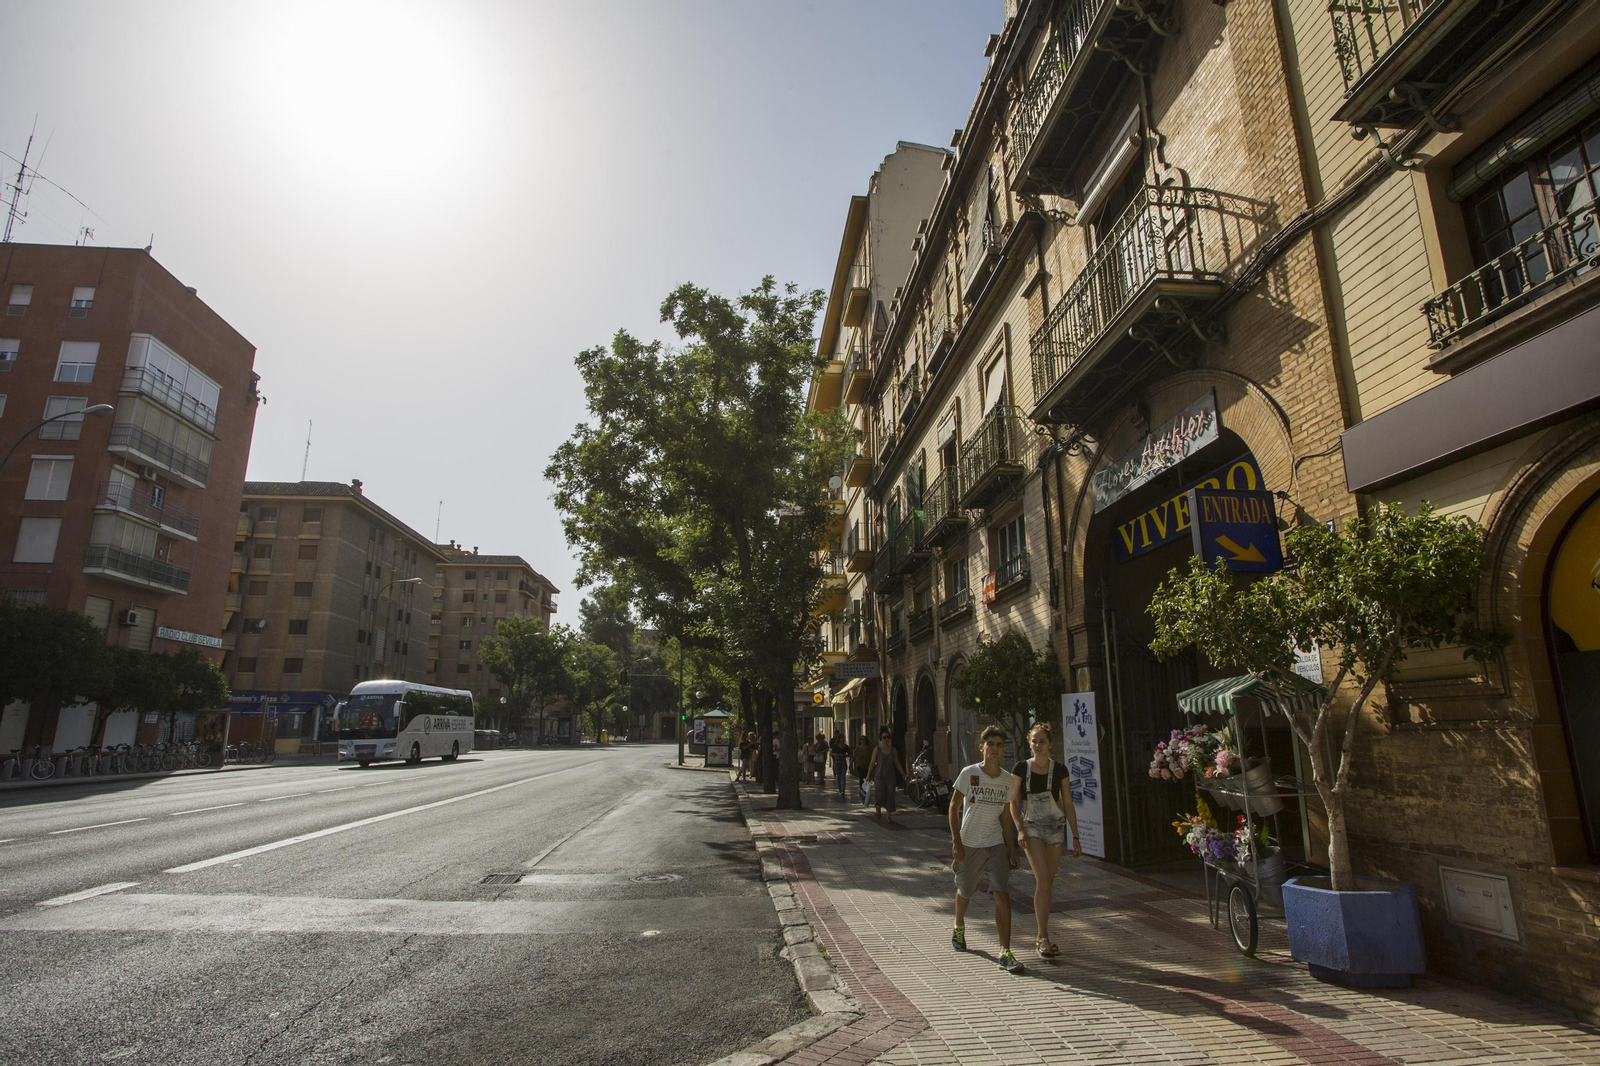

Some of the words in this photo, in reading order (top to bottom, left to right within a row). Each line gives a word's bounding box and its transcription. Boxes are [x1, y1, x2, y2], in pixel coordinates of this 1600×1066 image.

[1202, 495, 1271, 524] ENTRADA
[160, 628, 180, 639] RADIO
[181, 632, 197, 643] CLUB
[198, 636, 221, 647] SEVILLA
[1311, 654, 1317, 662] DE
[228, 694, 257, 702] Domino's
[433, 718, 451, 730] ARRIVA
[452, 719, 466, 730] ESFERA
